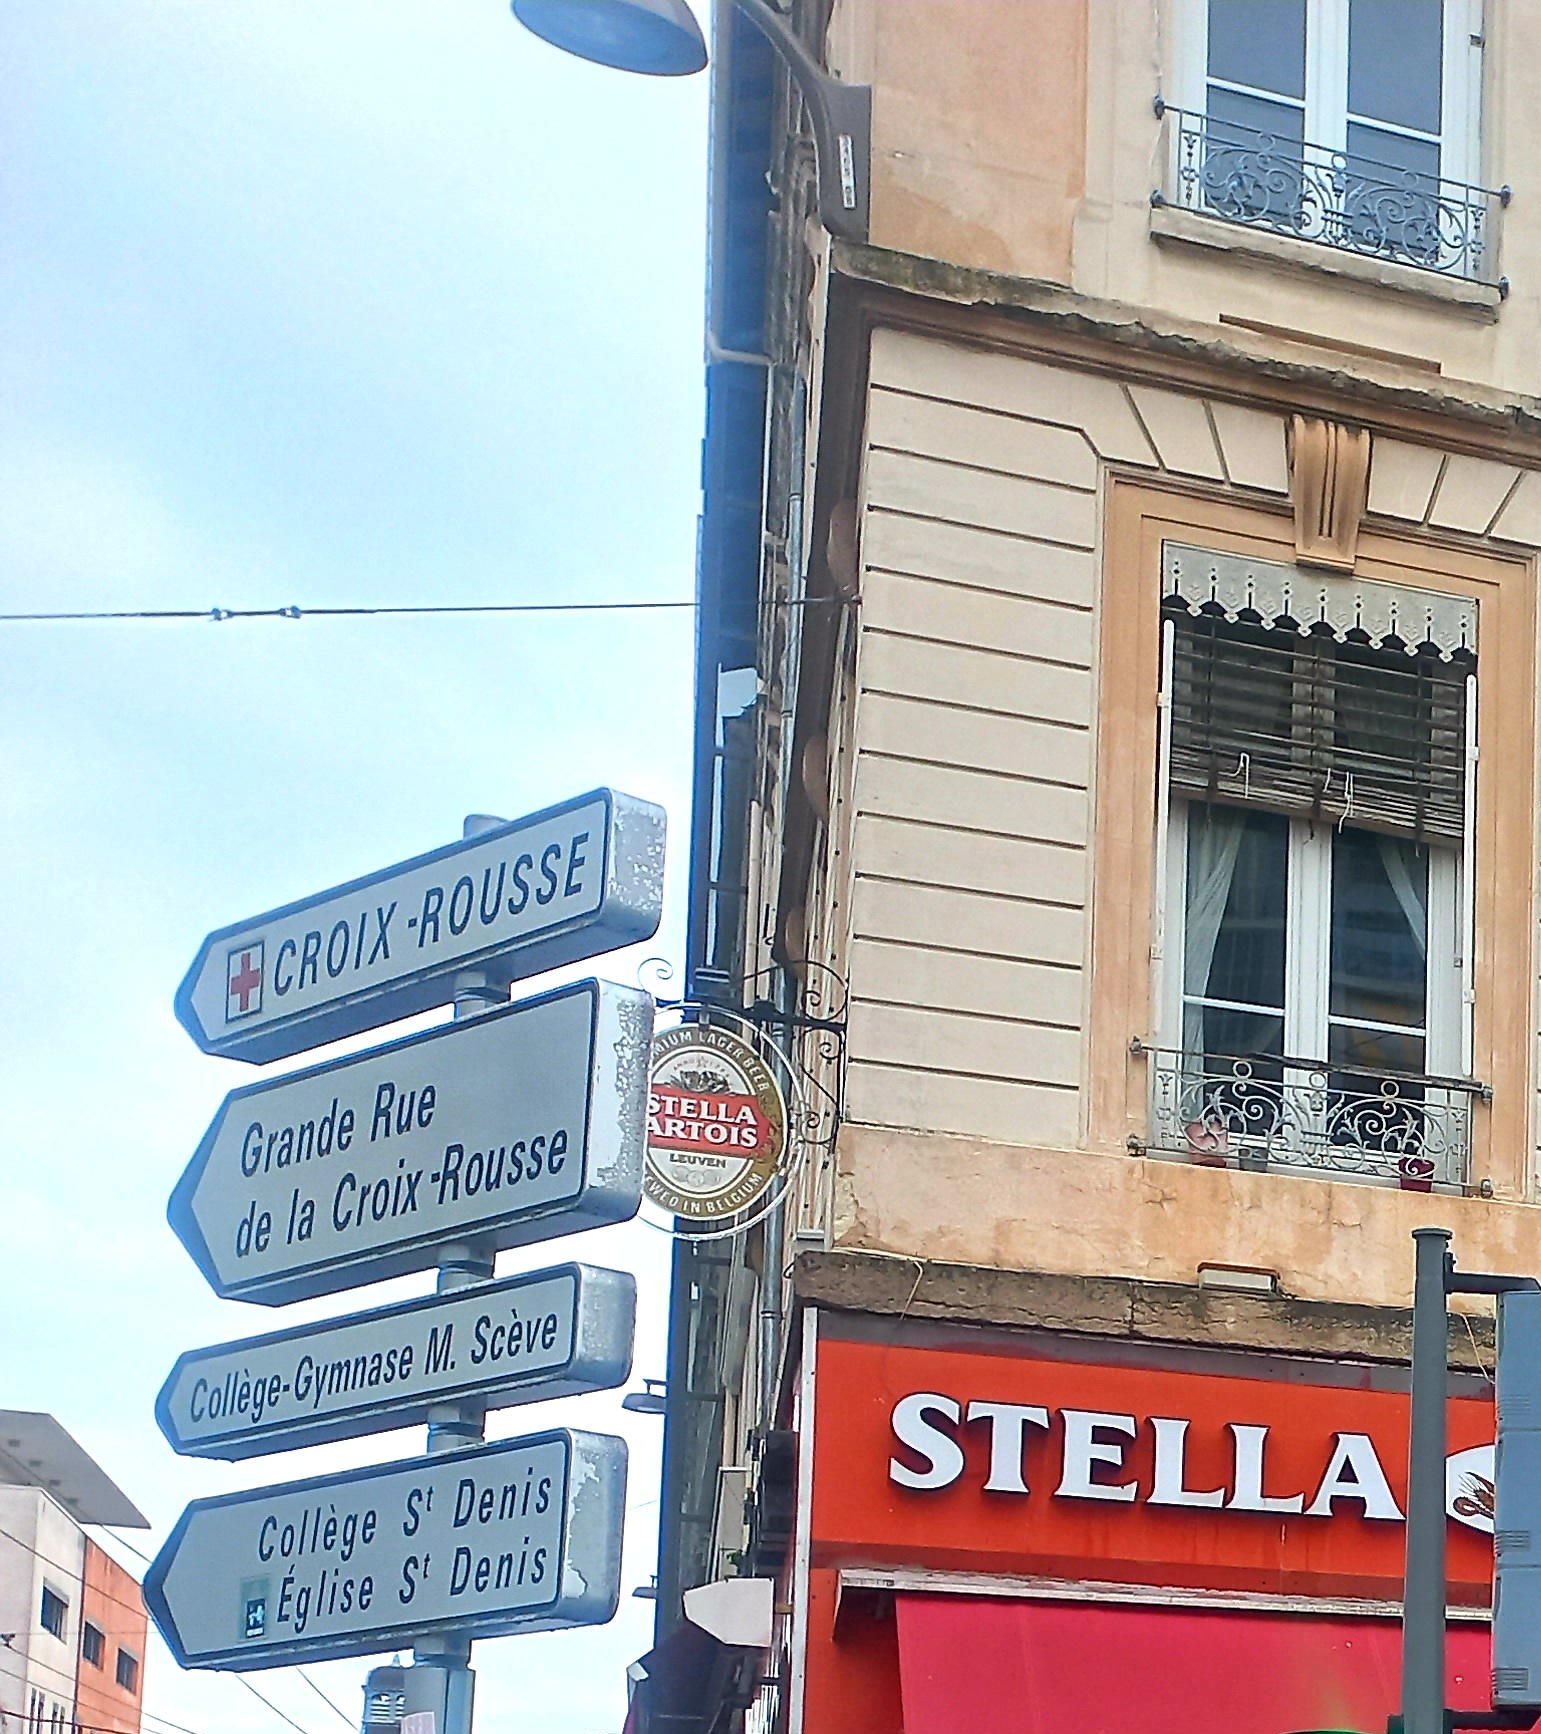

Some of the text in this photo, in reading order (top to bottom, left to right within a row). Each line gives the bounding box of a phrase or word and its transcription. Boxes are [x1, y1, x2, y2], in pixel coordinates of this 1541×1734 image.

[699, 1031, 744, 1059] LAGER
[743, 1057, 770, 1092] BEER
[242, 1083, 437, 1179] Grande Rue
[647, 1093, 757, 1126] STELLA
[647, 1116, 758, 1148] ARTOIS
[236, 1129, 569, 1259] de la Croix-Rousse
[670, 1154, 726, 1168] LEUVEN
[683, 1201, 700, 1213] IN
[706, 1172, 763, 1213] BELGIUM
[190, 1308, 558, 1423] Collège-Gymnase M. Scève
[889, 1393, 1406, 1521] STELLA
[258, 1467, 552, 1563] Collège St Denis
[278, 1537, 547, 1632] Église St Denis
